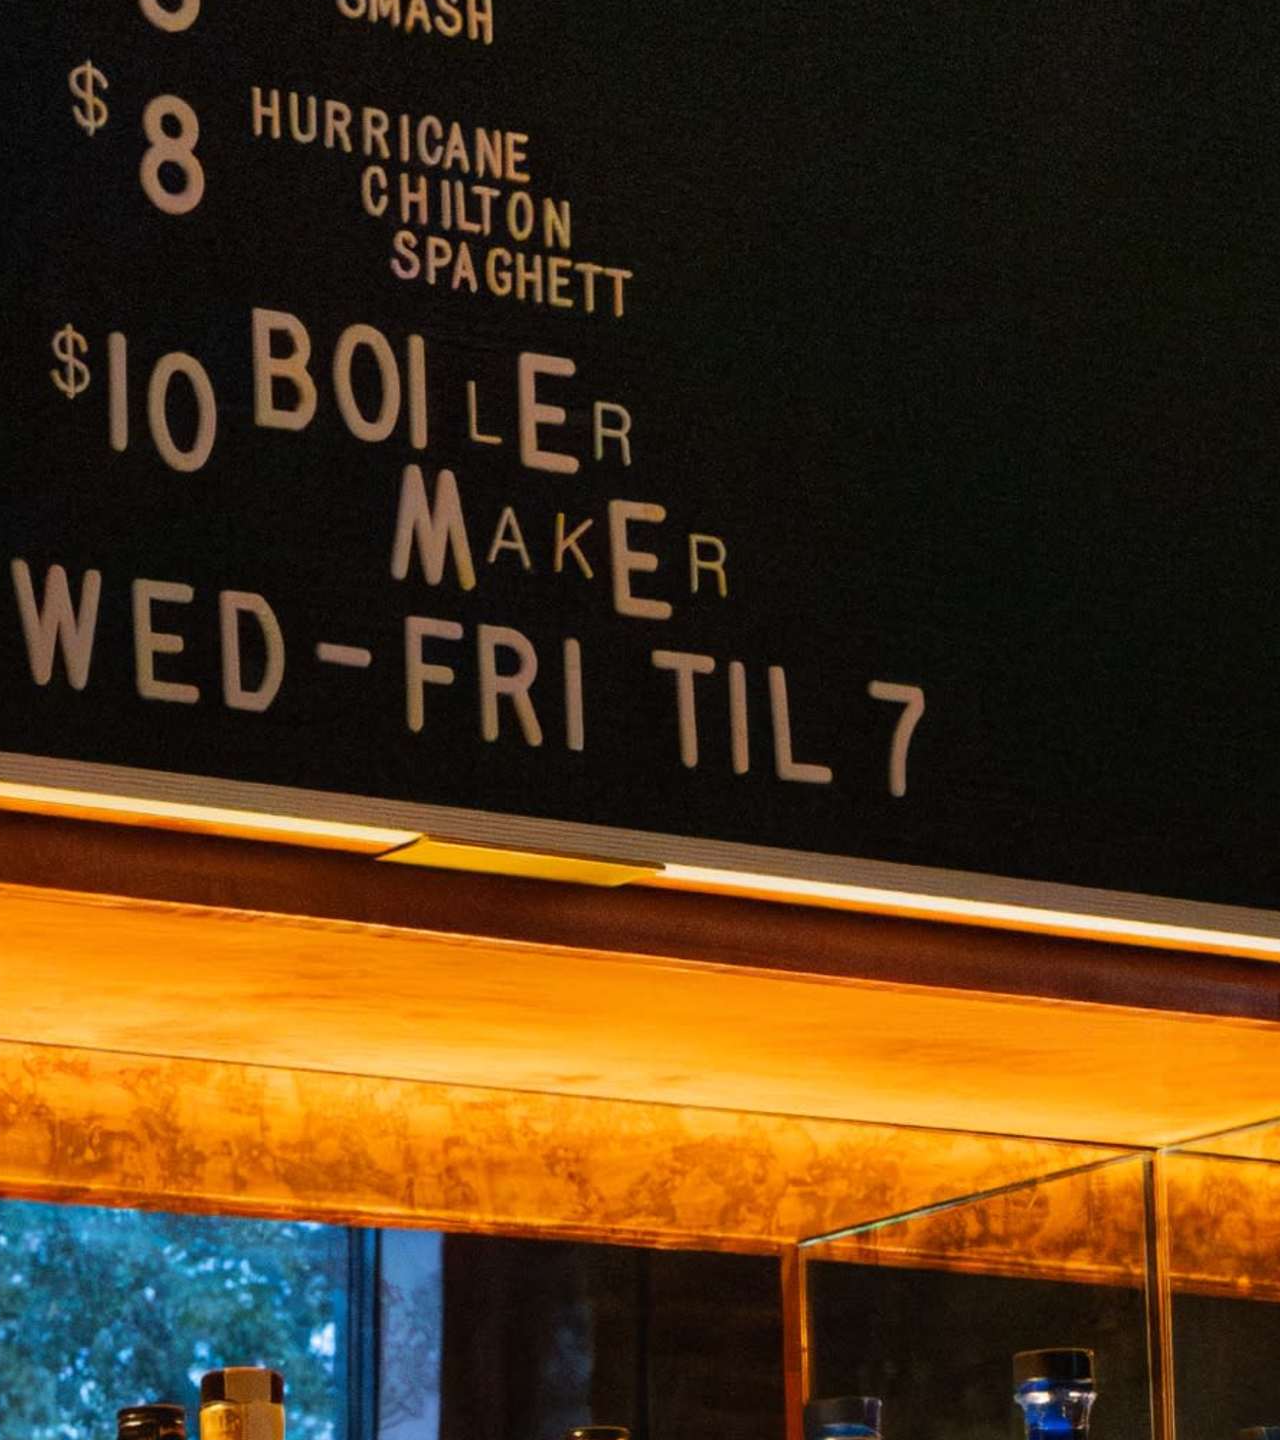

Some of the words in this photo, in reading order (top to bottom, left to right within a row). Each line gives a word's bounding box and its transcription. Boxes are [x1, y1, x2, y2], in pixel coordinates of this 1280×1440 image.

[252, 86, 531, 184] HURRICANE
[361, 165, 571, 249] CHILTON
[390, 229, 633, 317] SPAGHETT
[252, 307, 632, 474] BOILER
[392, 464, 727, 620] MAKER
[652, 649, 833, 784] TIL
[869, 680, 925, 796] 7
